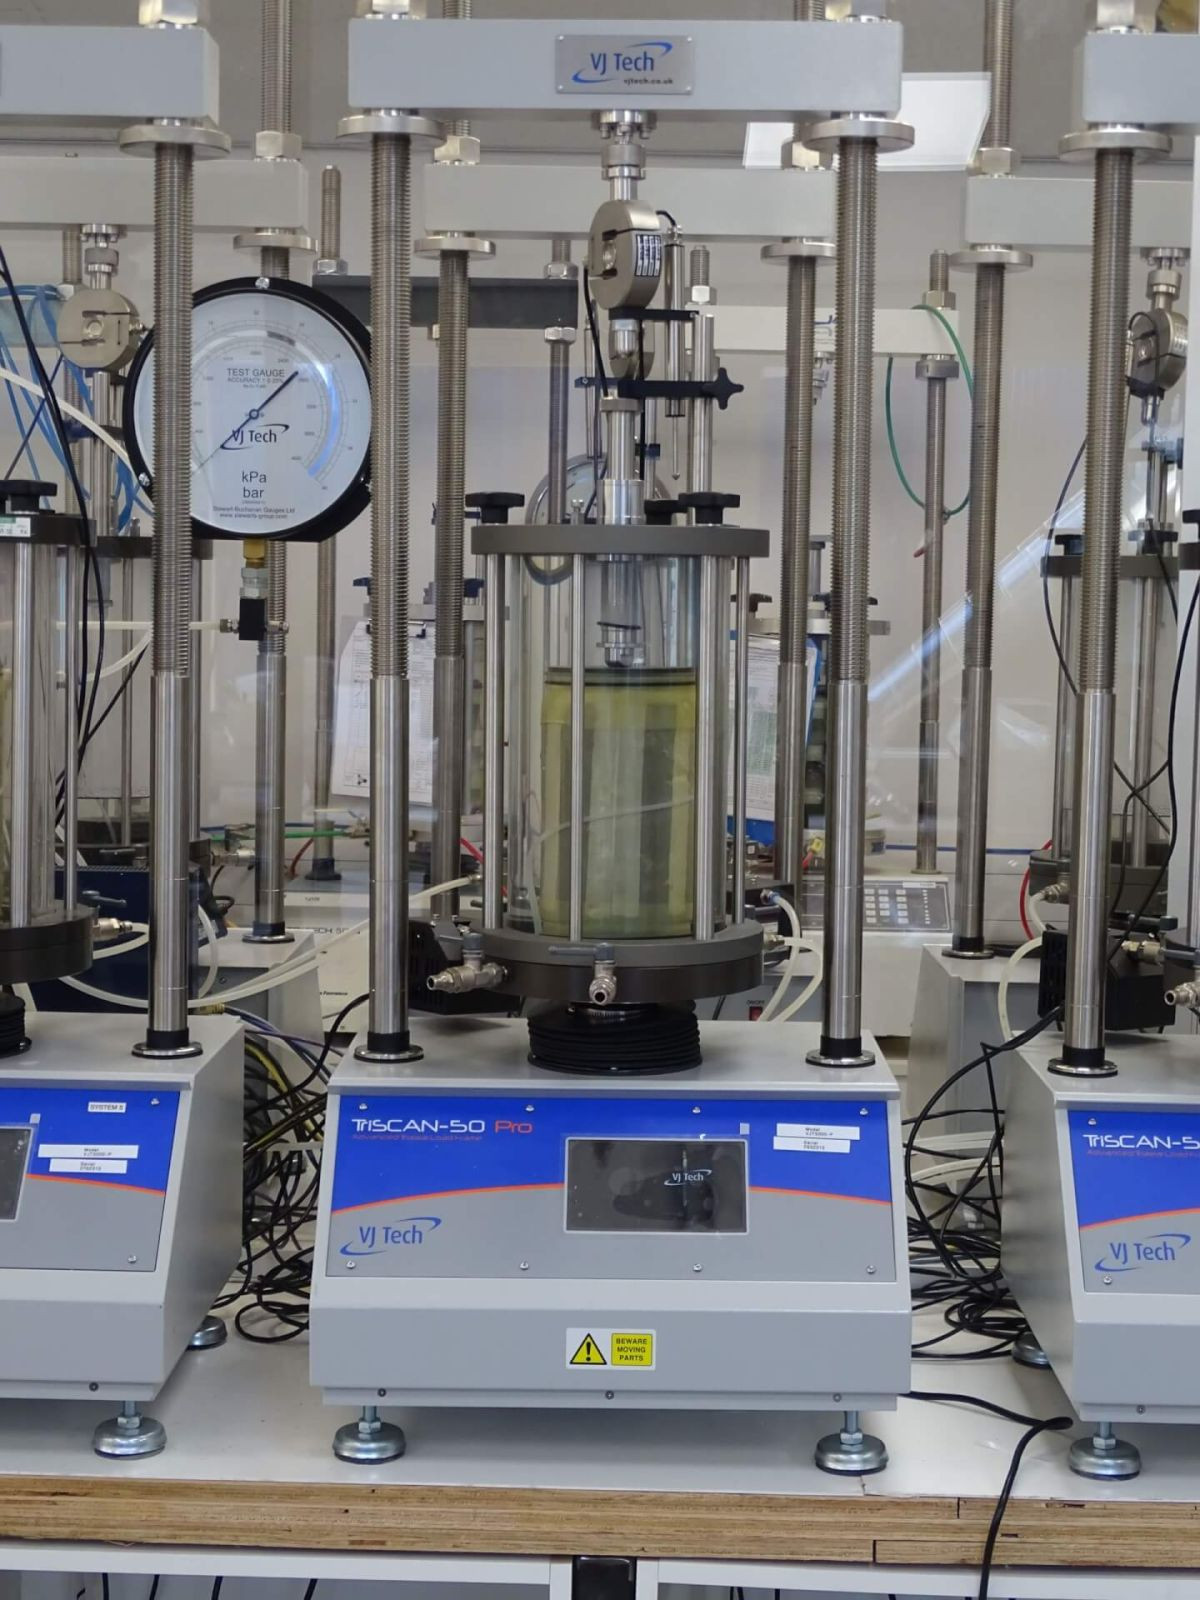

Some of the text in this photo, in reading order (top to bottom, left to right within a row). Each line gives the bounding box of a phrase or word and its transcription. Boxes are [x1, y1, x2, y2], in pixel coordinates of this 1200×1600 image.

[590, 51, 654, 75] VJ Tech
[227, 367, 286, 378] TEST GAUGE
[231, 428, 277, 446] VJ Tech
[241, 470, 267, 484] kPa
[243, 486, 264, 499] bar
[90, 1103, 118, 1111] SYSTEM
[494, 1120, 533, 1134] Pro
[672, 1171, 704, 1183] VJ Tech
[359, 1224, 422, 1248] VJ Tech
[1110, 1241, 1175, 1265] VJ Tech
